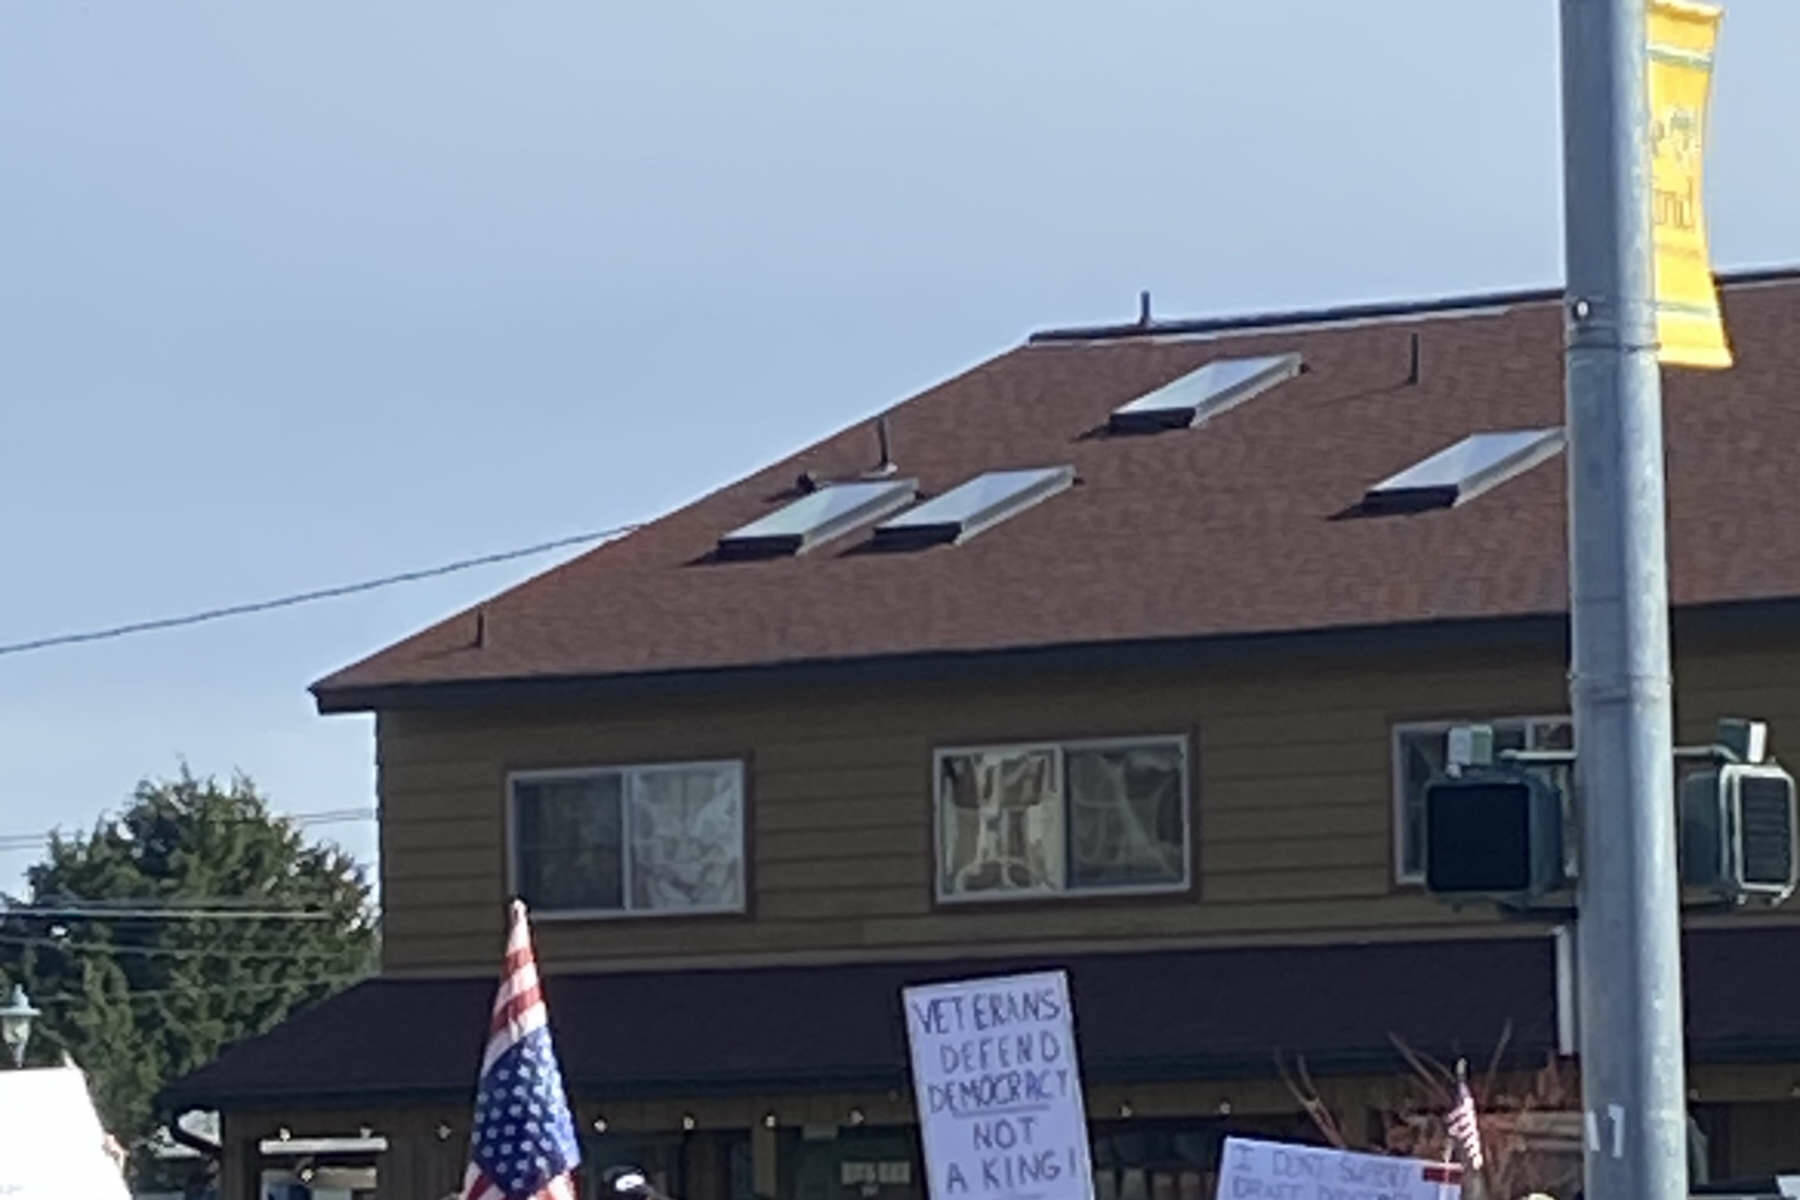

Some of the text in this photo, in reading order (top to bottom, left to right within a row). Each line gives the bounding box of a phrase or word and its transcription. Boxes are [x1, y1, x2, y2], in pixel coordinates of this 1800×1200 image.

[912, 989, 1061, 1035] VETERANS
[939, 1030, 1061, 1075] DEFEND
[927, 1068, 1069, 1114] DEMOCRACY
[973, 1116, 1037, 1151] NOT
[946, 1161, 968, 1194] A
